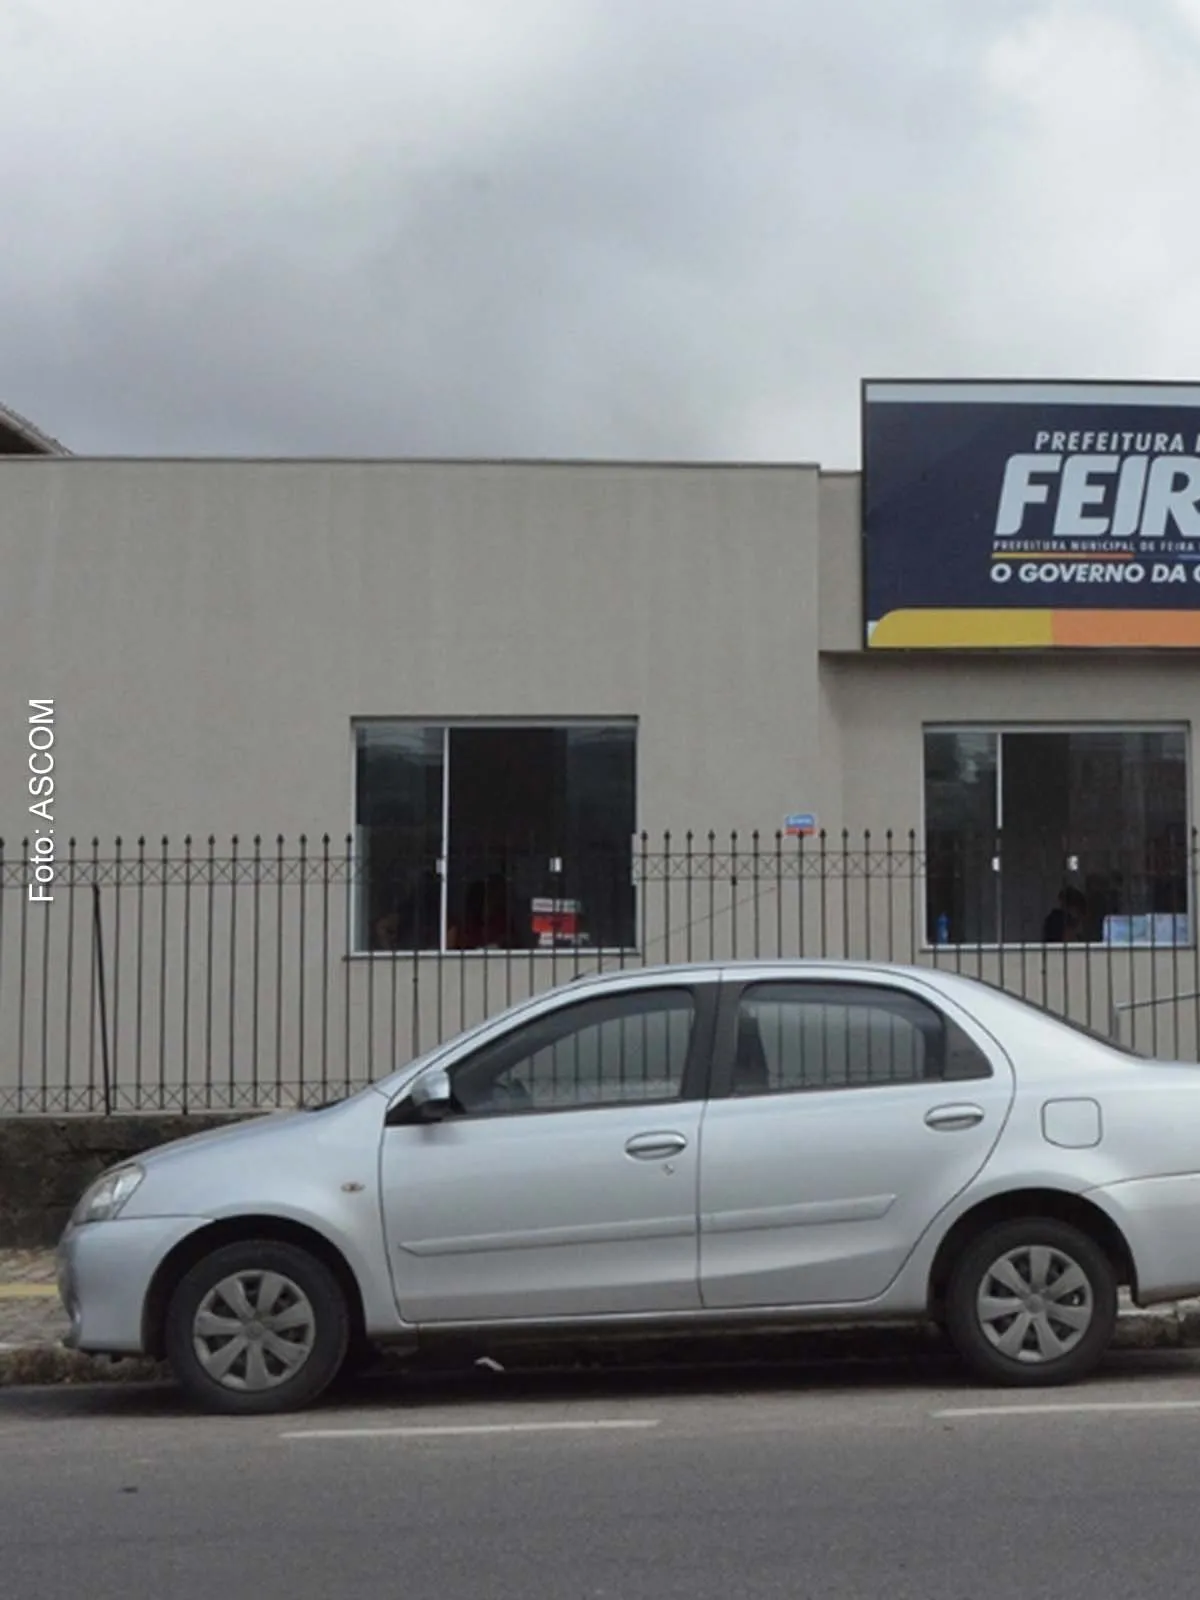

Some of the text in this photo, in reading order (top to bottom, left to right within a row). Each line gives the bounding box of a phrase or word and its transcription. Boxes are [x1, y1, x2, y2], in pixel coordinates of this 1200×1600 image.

[1034, 431, 1185, 453] PREFEITURA
[993, 539, 1067, 551] PREFEITURA
[1071, 540, 1135, 552] MUNICIPAL
[1160, 541, 1195, 552] FEIRA
[990, 563, 1012, 584] O
[1018, 563, 1145, 584] GOVERNO
[1151, 563, 1187, 584] DA
